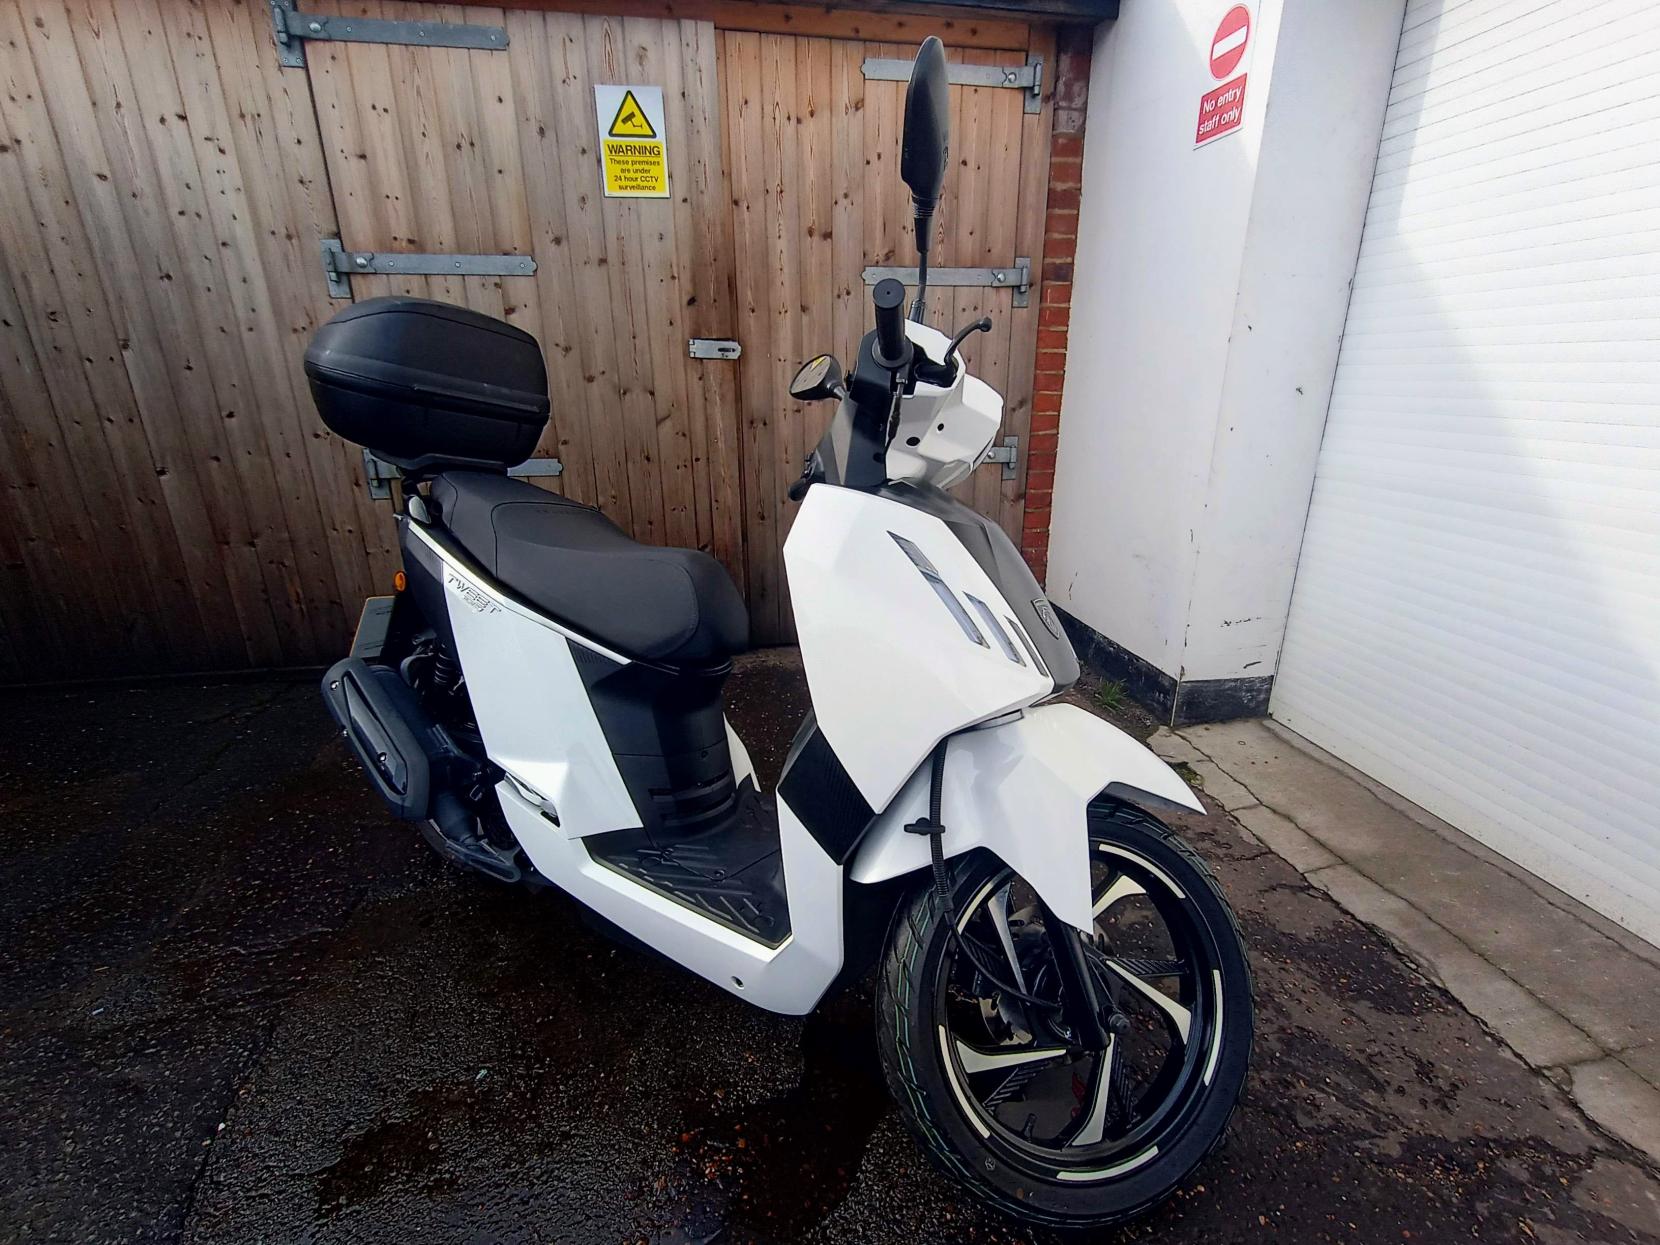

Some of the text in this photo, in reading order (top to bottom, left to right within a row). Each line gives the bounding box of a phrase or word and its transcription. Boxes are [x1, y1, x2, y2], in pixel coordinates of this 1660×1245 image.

[1203, 86, 1242, 114] No entry
[1198, 106, 1241, 135] staff only
[607, 143, 661, 156] WARNING
[609, 158, 661, 167] These premises
[639, 175, 659, 183] CCTV
[448, 573, 502, 613] TWEET
